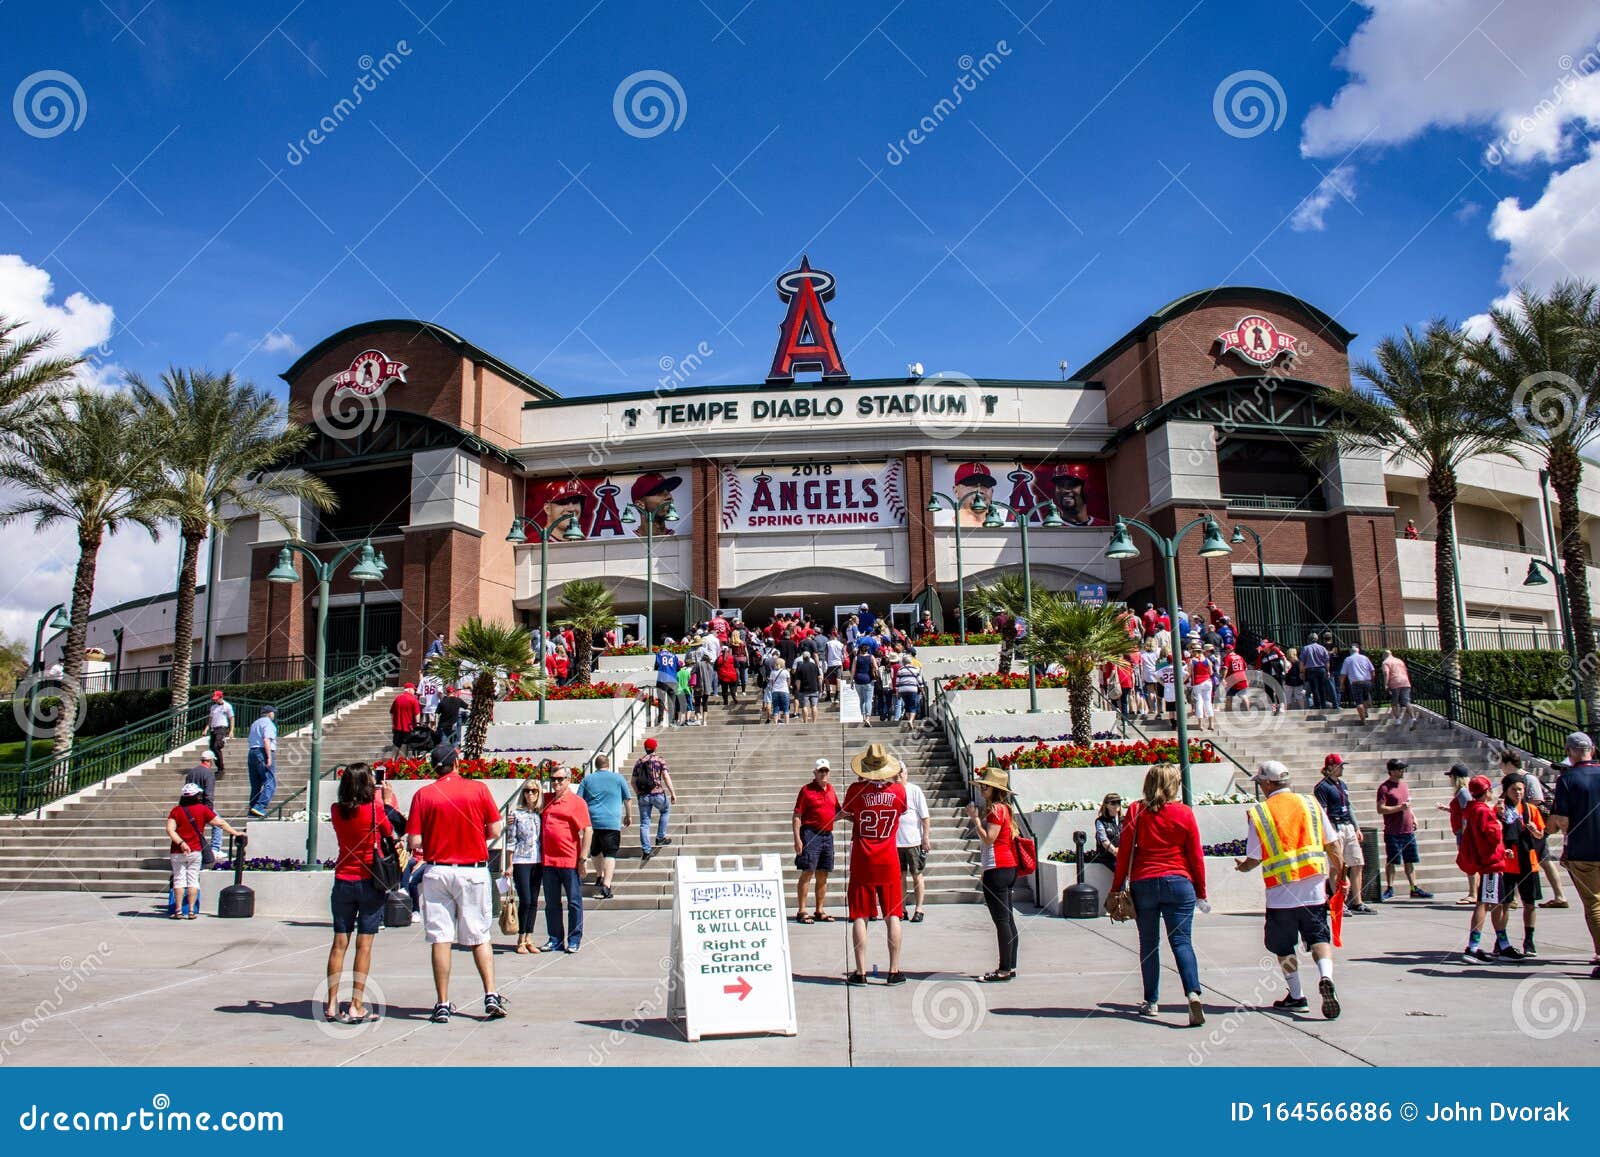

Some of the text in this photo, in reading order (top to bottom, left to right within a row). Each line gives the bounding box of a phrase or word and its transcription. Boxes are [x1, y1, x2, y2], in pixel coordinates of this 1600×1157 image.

[656, 394, 967, 425] TEMPE DIABLO STADIUM
[792, 464, 833, 477] 2018
[750, 470, 879, 511] ANGELS
[748, 512, 880, 527] SPRING TRAINING
[661, 655, 674, 667] 84
[862, 792, 897, 807] TROUT
[859, 809, 897, 838] 27
[691, 882, 772, 905] Tempe Diablo
[689, 907, 777, 921] TICKET OFFICE
[697, 921, 772, 934] & WILL CALL
[703, 938, 768, 952] Right of
[711, 951, 760, 963] Grand
[701, 962, 773, 974] Entrance
